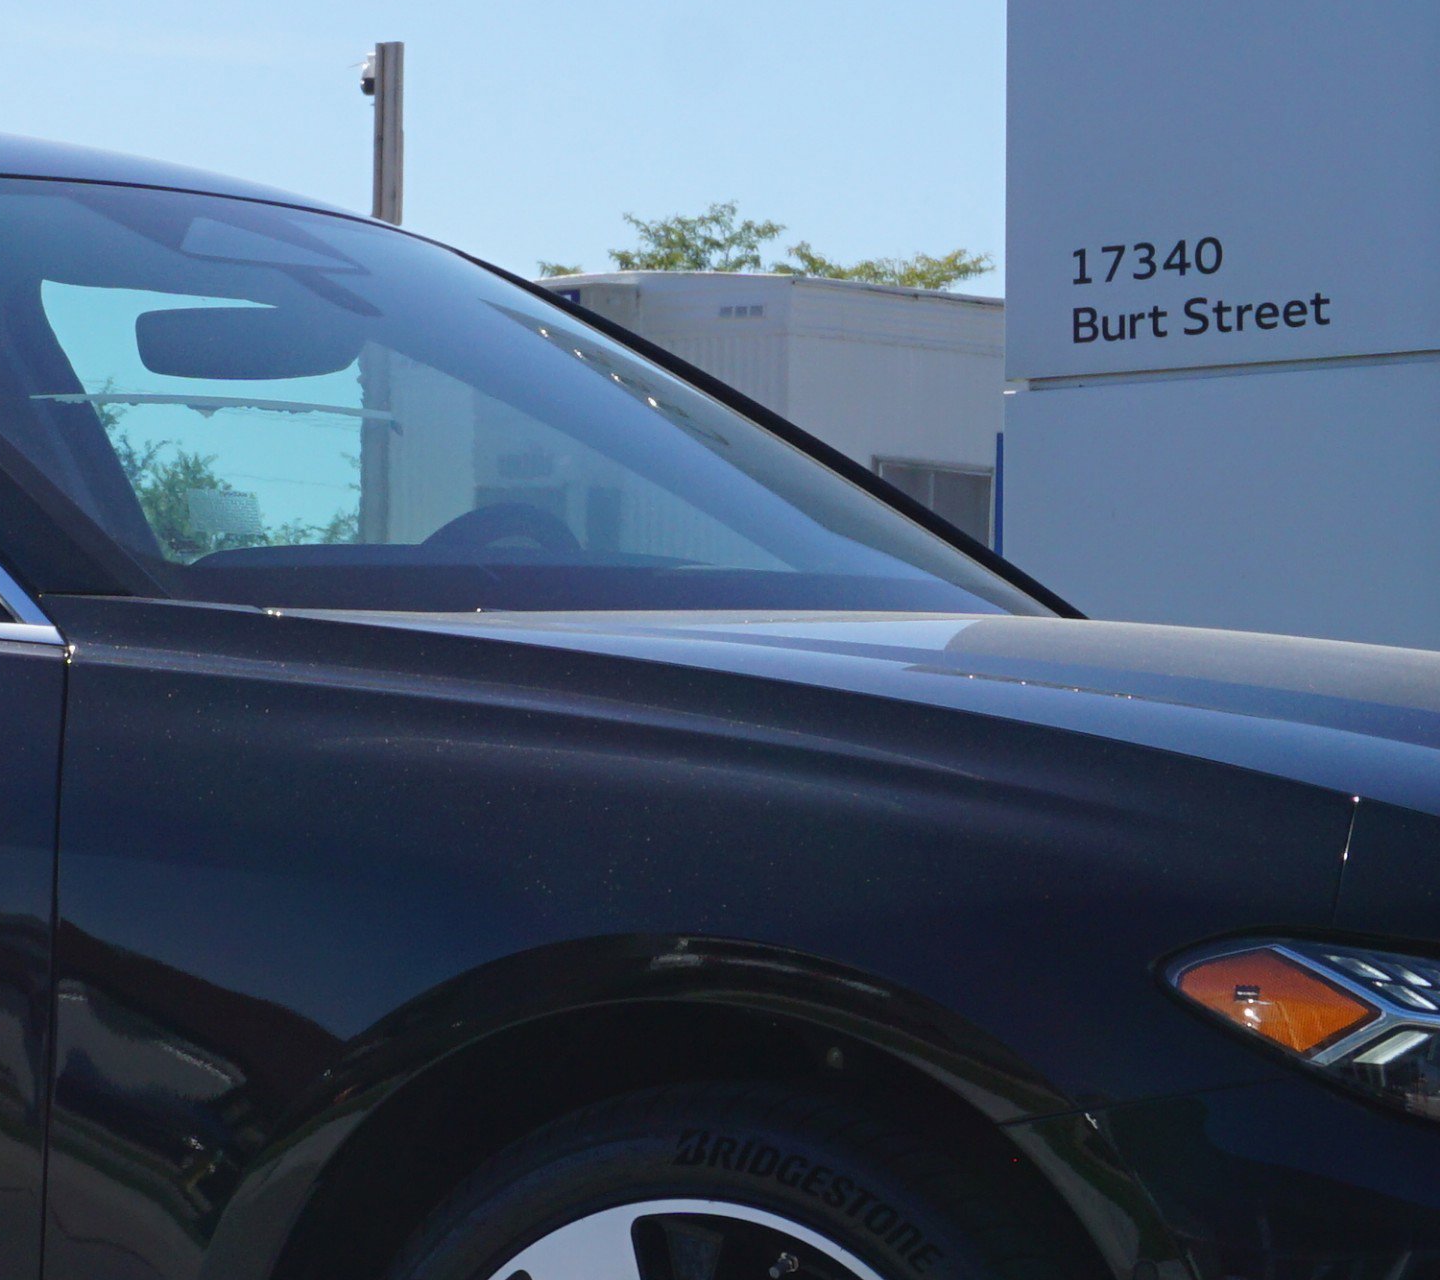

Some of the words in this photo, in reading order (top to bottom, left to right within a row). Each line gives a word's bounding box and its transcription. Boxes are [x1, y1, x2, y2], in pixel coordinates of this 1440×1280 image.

[1072, 235, 1224, 286] 17340
[1072, 303, 1168, 344] Burt
[1183, 291, 1331, 336] Street
[671, 1127, 945, 1275] BRIDGESTONE
